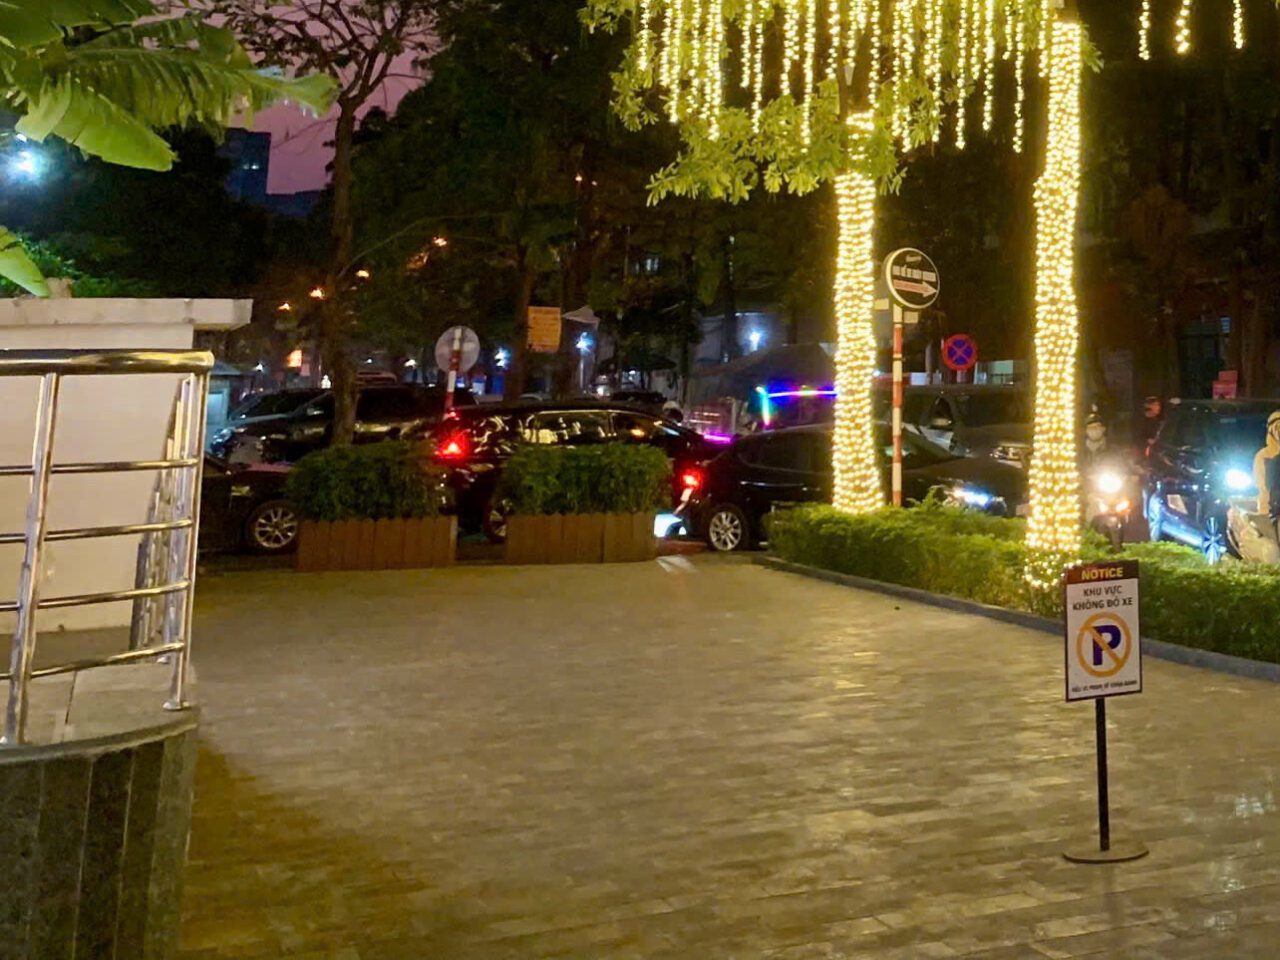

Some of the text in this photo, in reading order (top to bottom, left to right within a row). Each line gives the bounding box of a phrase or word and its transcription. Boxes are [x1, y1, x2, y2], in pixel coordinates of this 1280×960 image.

[1081, 567, 1123, 580] NOTICE
[1083, 584, 1122, 596] KHU VỰC
[1072, 598, 1104, 611] KHÔNG
[1122, 596, 1133, 606] XE
